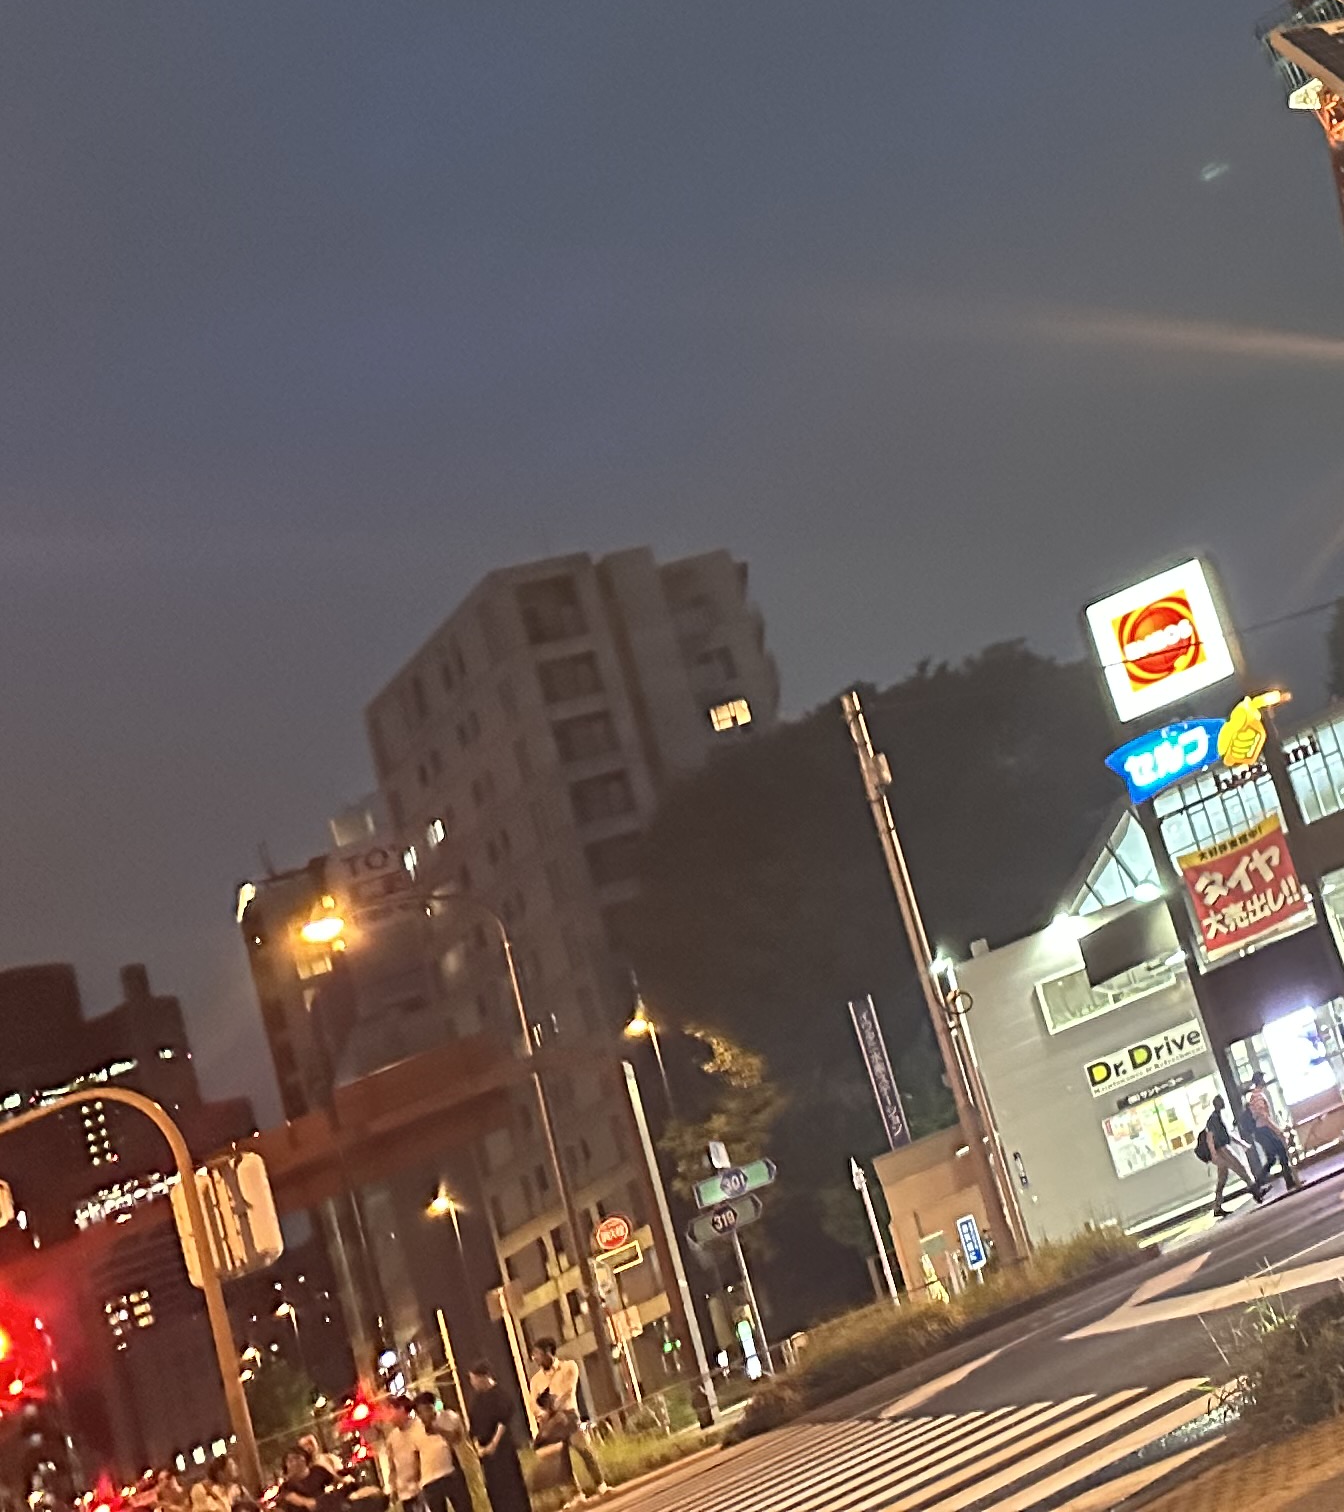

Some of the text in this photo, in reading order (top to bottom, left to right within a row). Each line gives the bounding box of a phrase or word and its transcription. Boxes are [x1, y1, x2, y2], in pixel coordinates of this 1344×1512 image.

[1195, 845, 1281, 906] タイヤ
[1087, 1030, 1200, 1087] Dr. Drive
